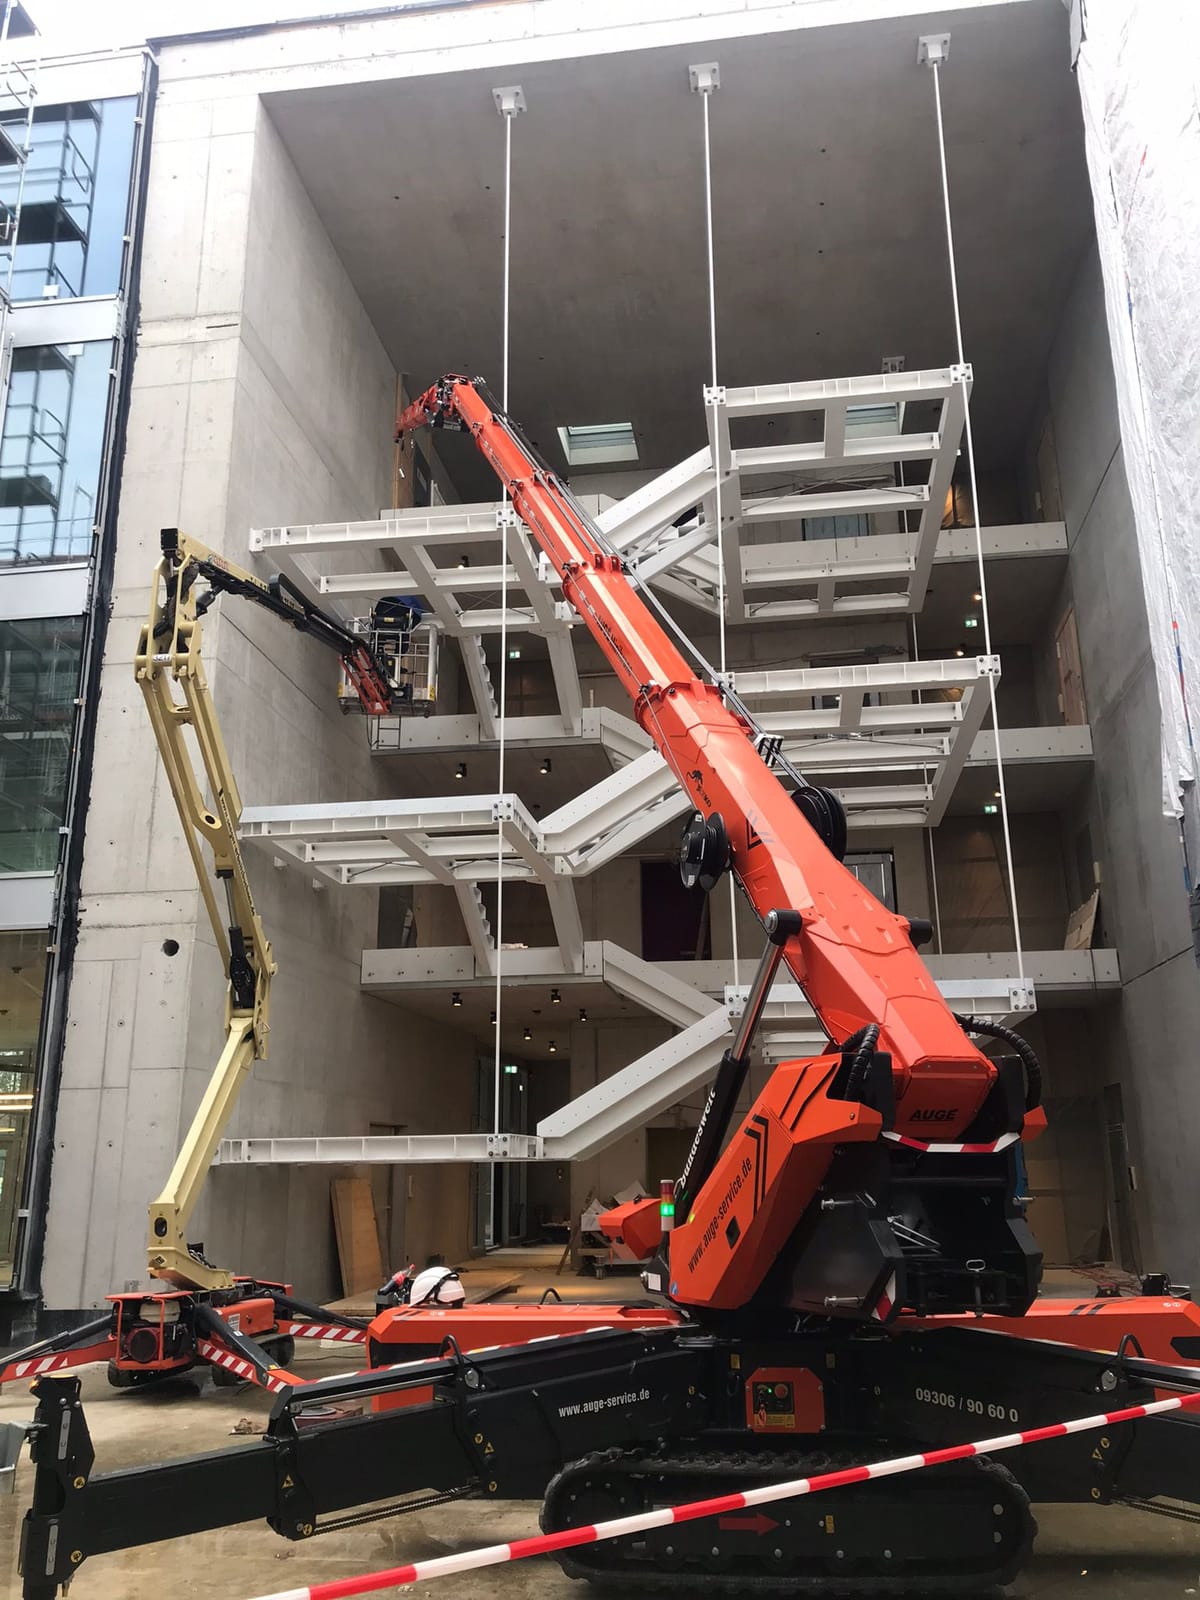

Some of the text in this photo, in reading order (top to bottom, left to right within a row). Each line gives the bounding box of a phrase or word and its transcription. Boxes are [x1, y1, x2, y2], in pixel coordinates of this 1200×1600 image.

[908, 1109, 959, 1122] AUGE
[687, 1157, 752, 1273] www.auge-service.de
[558, 1388, 650, 1417] www.auge-service.de
[915, 1387, 1019, 1422] 09306 / 90 60 0
